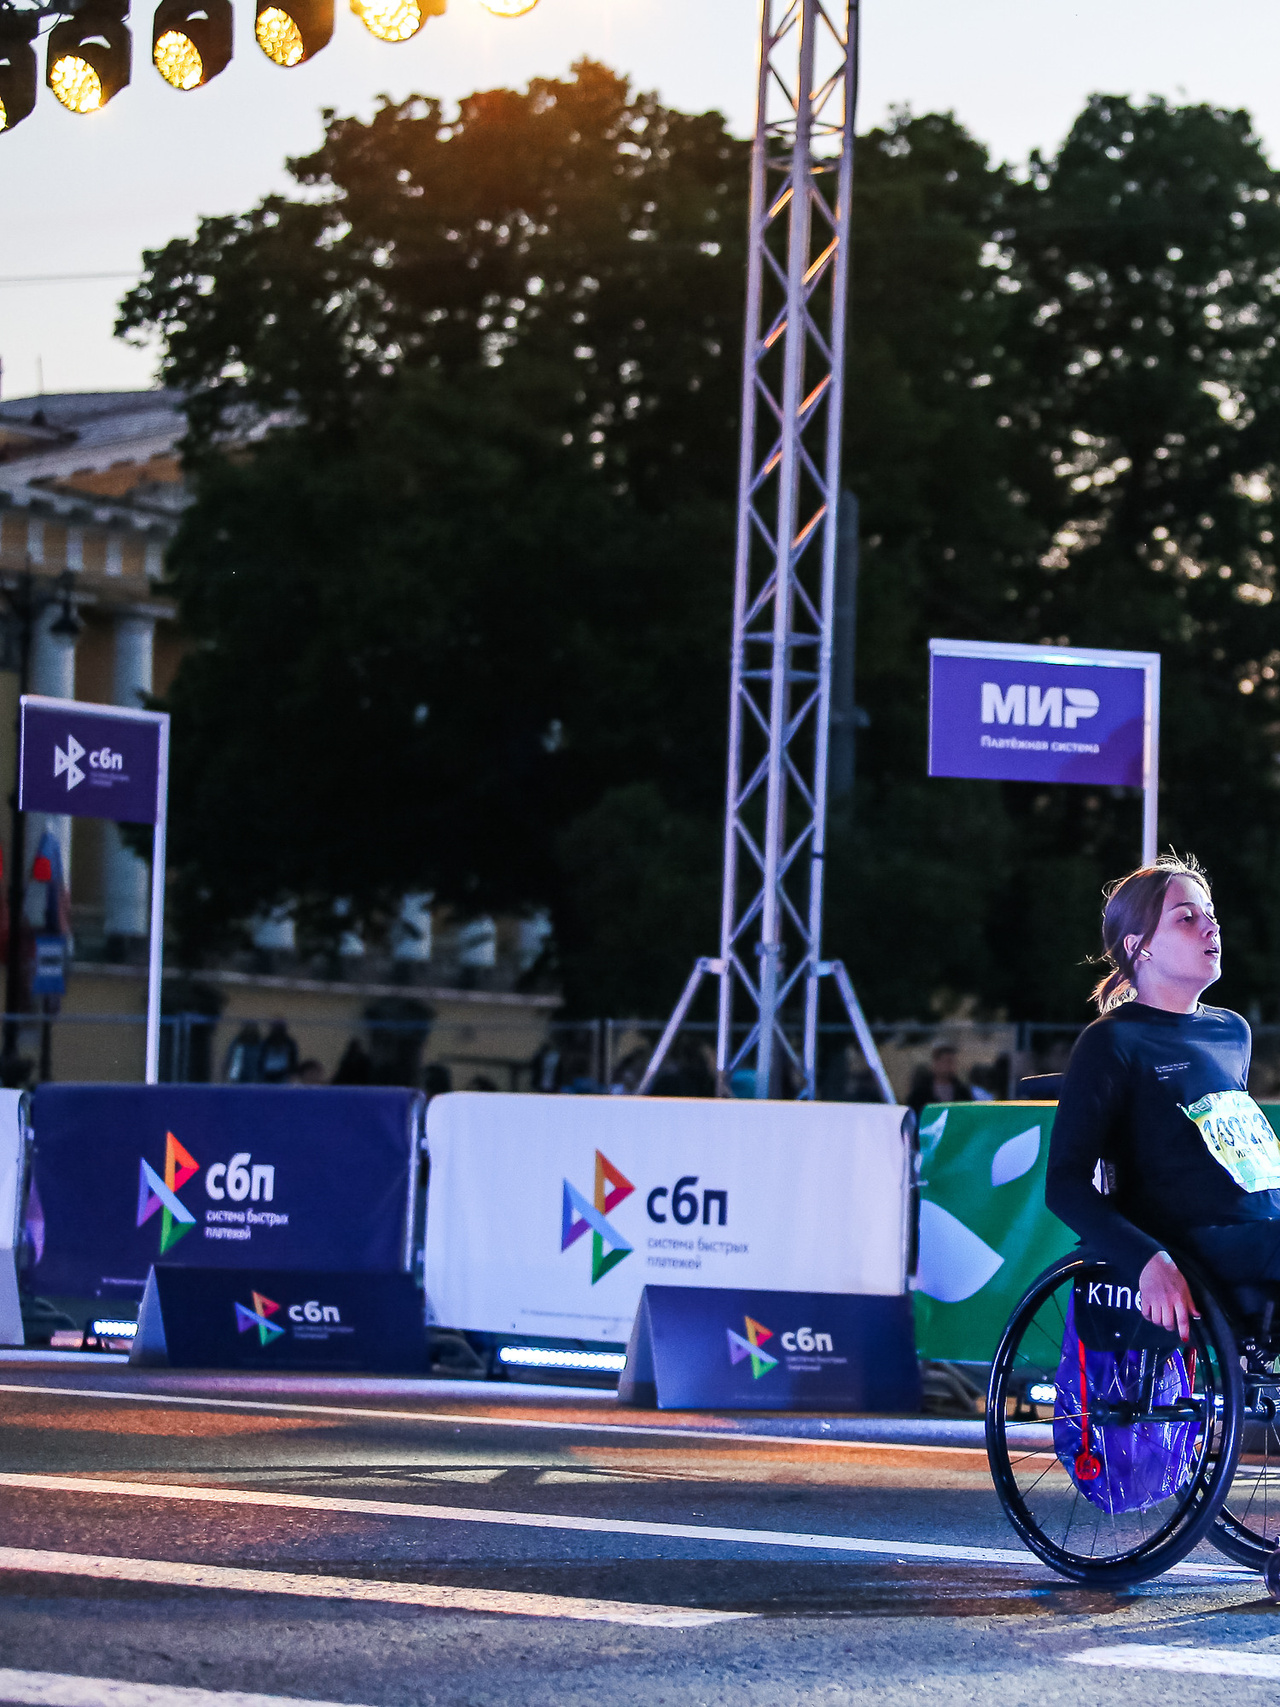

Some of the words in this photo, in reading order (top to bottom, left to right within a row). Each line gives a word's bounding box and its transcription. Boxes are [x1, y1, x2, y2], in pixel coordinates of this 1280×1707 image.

[981, 682, 1100, 729] МИР
[980, 735, 1048, 751] Платёжная
[1051, 741, 1100, 754] система
[89, 746, 123, 771] сбп
[205, 1152, 275, 1202] сбп
[647, 1176, 727, 1226] сбп
[647, 1238, 694, 1251] система
[697, 1236, 749, 1256] быстрых
[288, 1300, 341, 1323] сбп
[781, 1326, 833, 1352] сбп
